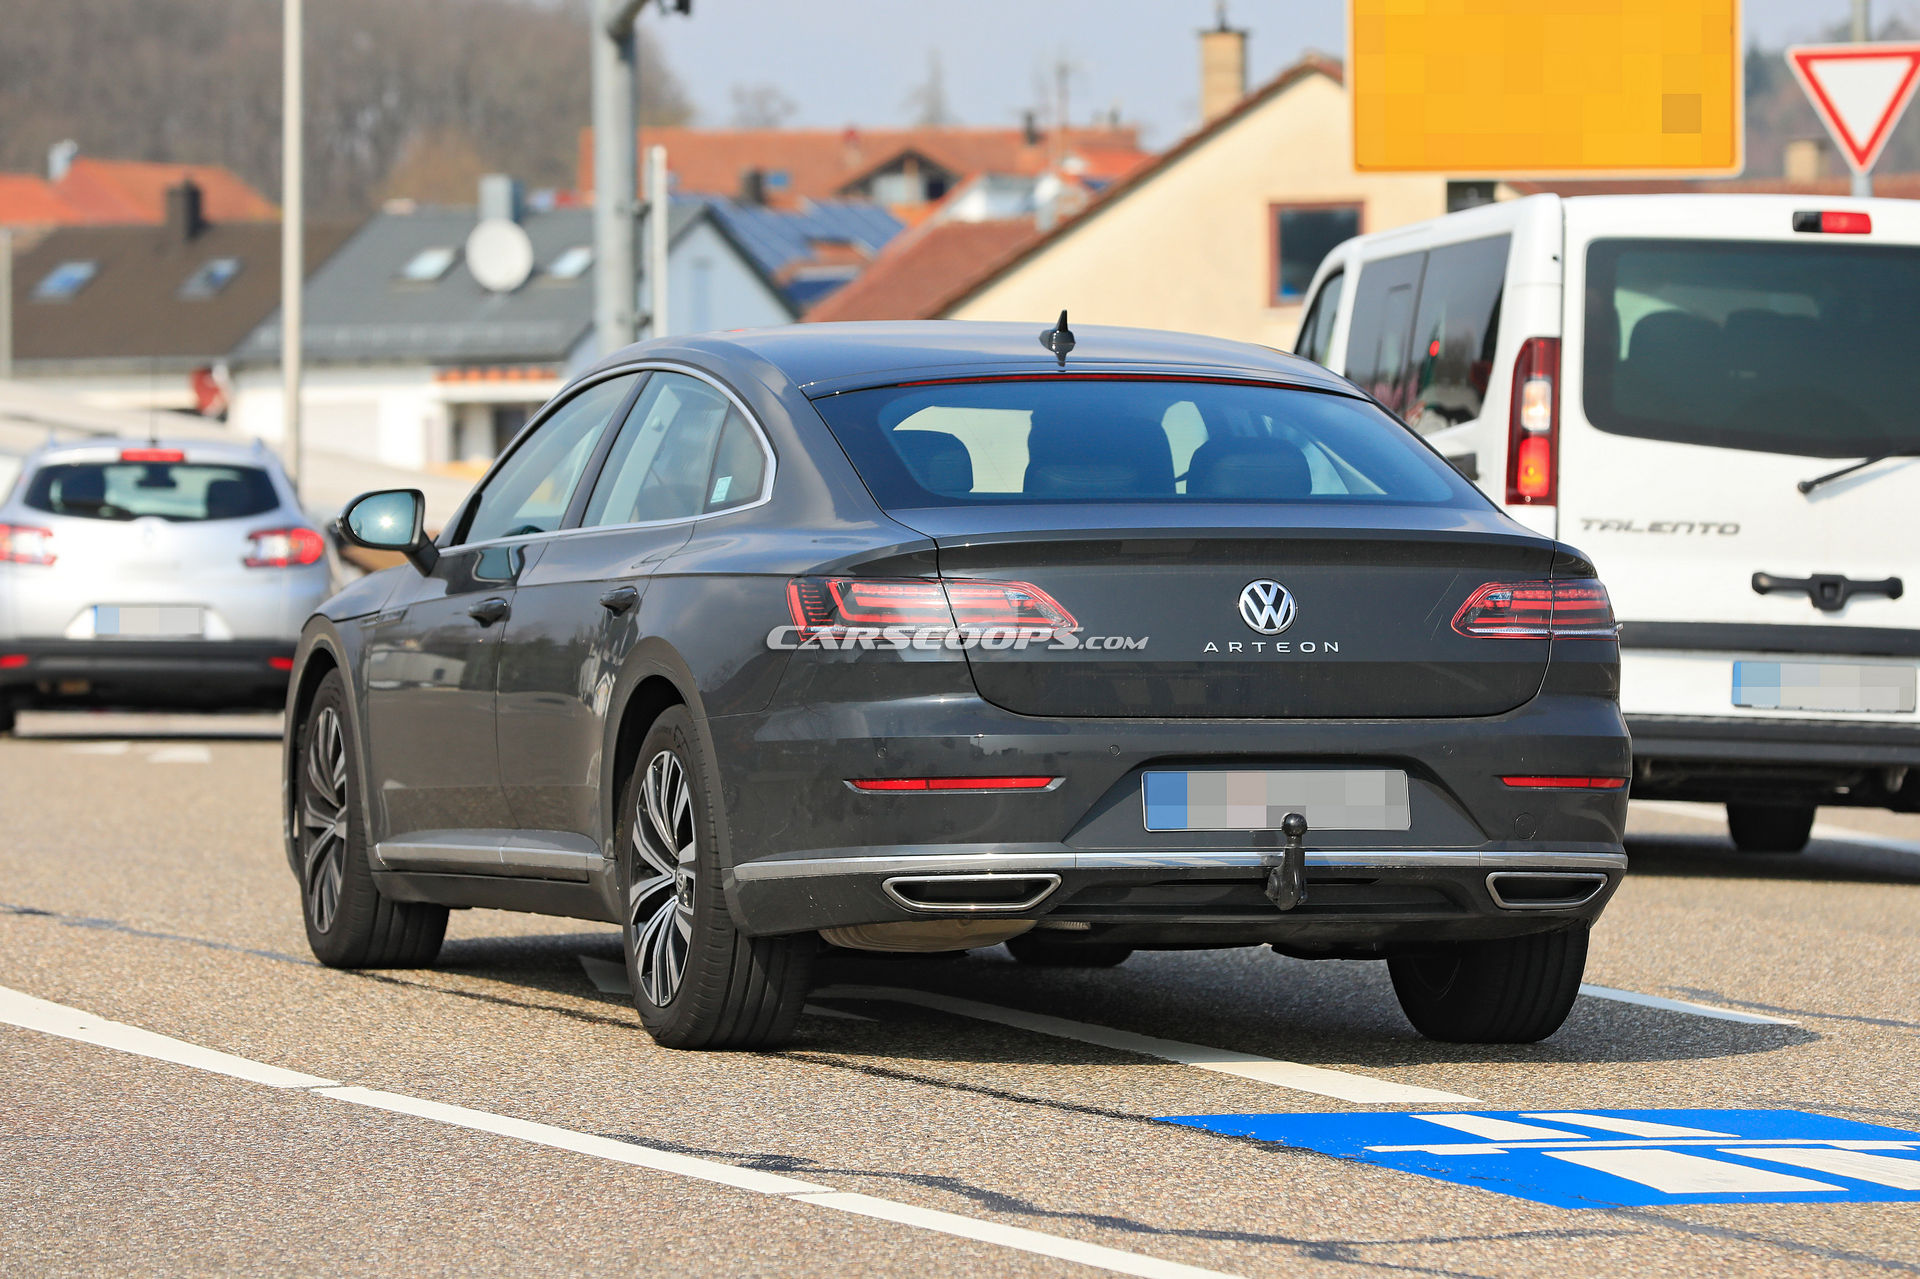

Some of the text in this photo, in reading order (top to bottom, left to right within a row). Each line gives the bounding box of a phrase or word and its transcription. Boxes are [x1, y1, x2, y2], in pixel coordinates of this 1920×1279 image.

[1580, 517, 1741, 535] TALENTO
[1240, 581, 1296, 633] VW
[1203, 641, 1340, 653] ARTEON
